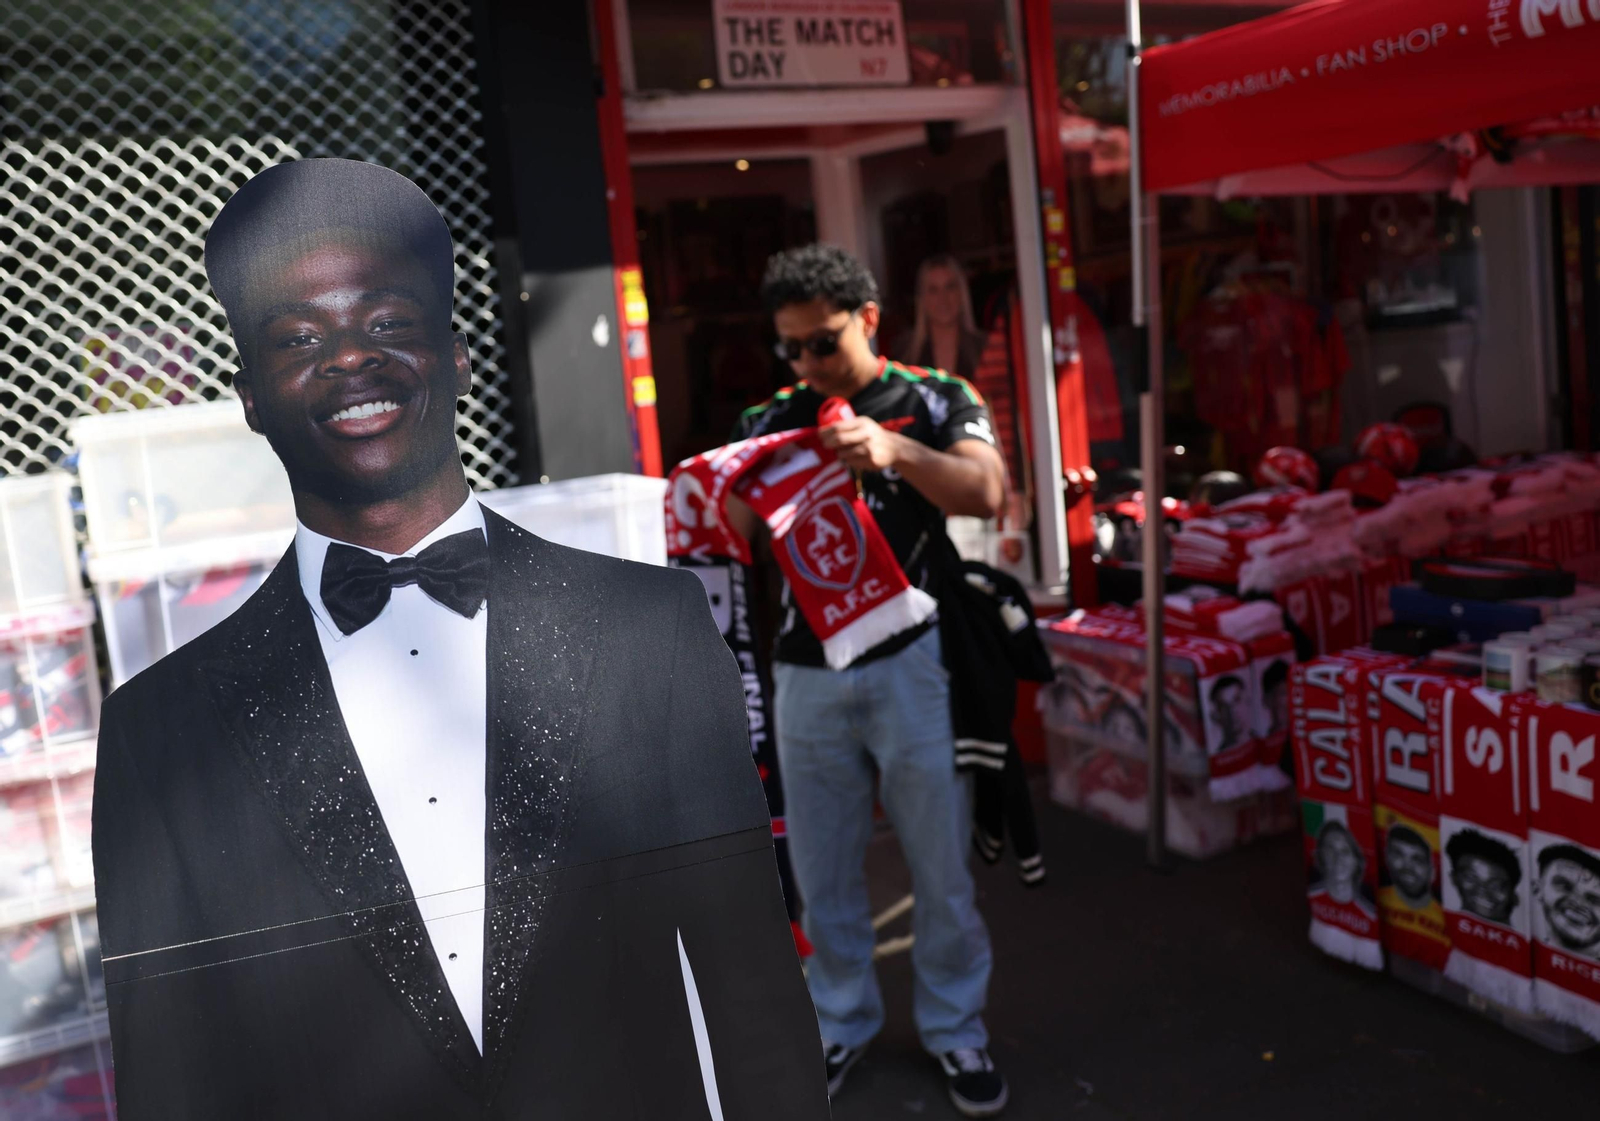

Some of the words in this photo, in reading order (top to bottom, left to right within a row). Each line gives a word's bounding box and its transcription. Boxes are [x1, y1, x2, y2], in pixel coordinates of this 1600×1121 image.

[724, 17, 786, 46] THE
[795, 18, 896, 47] MATCH
[727, 51, 787, 80] DAY
[1158, 67, 1295, 118] MEMORABILIA
[1316, 46, 1366, 77] FAN
[1374, 23, 1449, 64] SHOP
[737, 651, 768, 755] FINAL
[1457, 918, 1521, 952] SAKA
